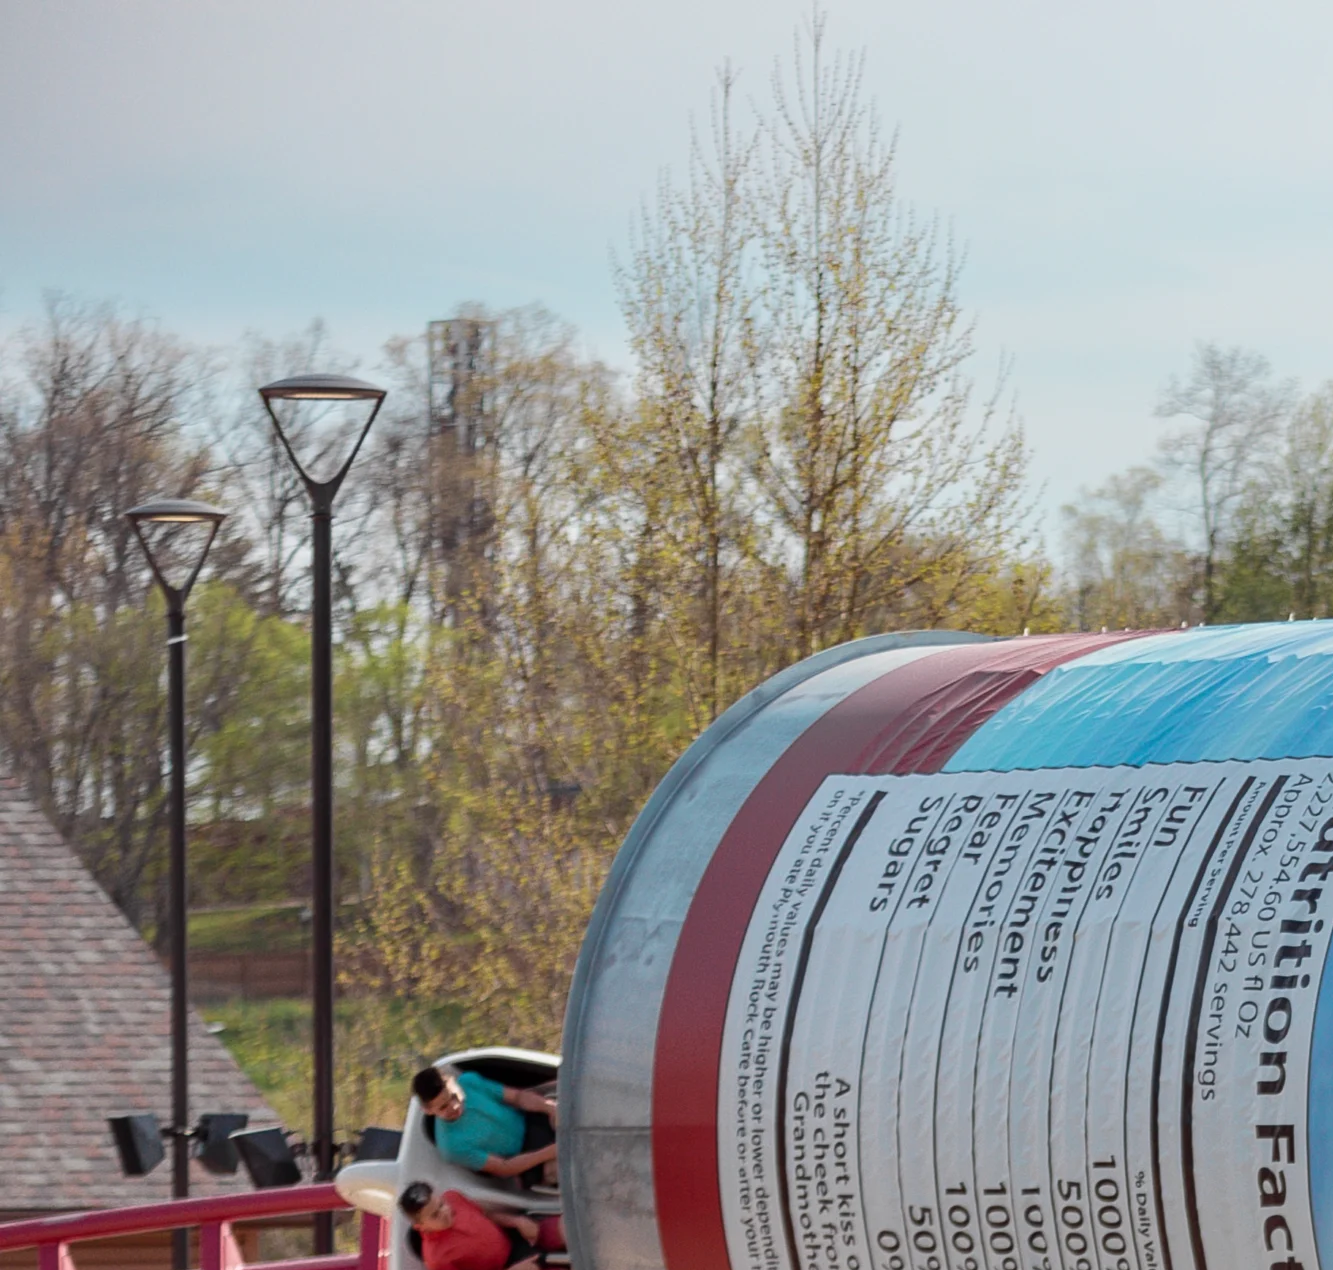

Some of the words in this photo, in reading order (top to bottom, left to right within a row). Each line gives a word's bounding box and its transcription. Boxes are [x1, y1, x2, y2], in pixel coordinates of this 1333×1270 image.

[826, 790, 845, 808] on
[1152, 786, 1208, 847] Fun
[1229, 781, 1267, 837] Amount
[1252, 773, 1314, 862] Approx.
[800, 825, 824, 854] you
[869, 796, 944, 912] Sugars
[905, 794, 984, 909] Regret
[962, 793, 1020, 866] Fear
[1095, 787, 1169, 901] Smiles
[1216, 840, 1234, 864] Per
[785, 859, 805, 884] ate
[796, 858, 825, 897] daily
[963, 793, 1057, 973] Memories
[993, 790, 1096, 999] Excitement
[1036, 788, 1133, 983] Happiness
[1187, 868, 1222, 928] Serving
[774, 902, 802, 958] values
[1216, 870, 1264, 973] 278,442
[1247, 931, 1272, 966] US
[745, 979, 767, 1023] Rock
[764, 962, 783, 1002] may
[1242, 975, 1264, 991] fl
[760, 1007, 779, 1030] be
[1197, 982, 1230, 1101] servings
[1234, 1000, 1259, 1040] Oz
[752, 1036, 773, 1097] higher
[833, 1078, 851, 1098] A
[751, 1103, 764, 1123] or
[813, 1071, 832, 1119] the
[751, 1130, 765, 1182] lower
[813, 1127, 834, 1215] cheek
[833, 1107, 852, 1185] short
[740, 1219, 760, 1260] your
[837, 1194, 857, 1247] kiss
[1135, 1193, 1151, 1237] Daily
